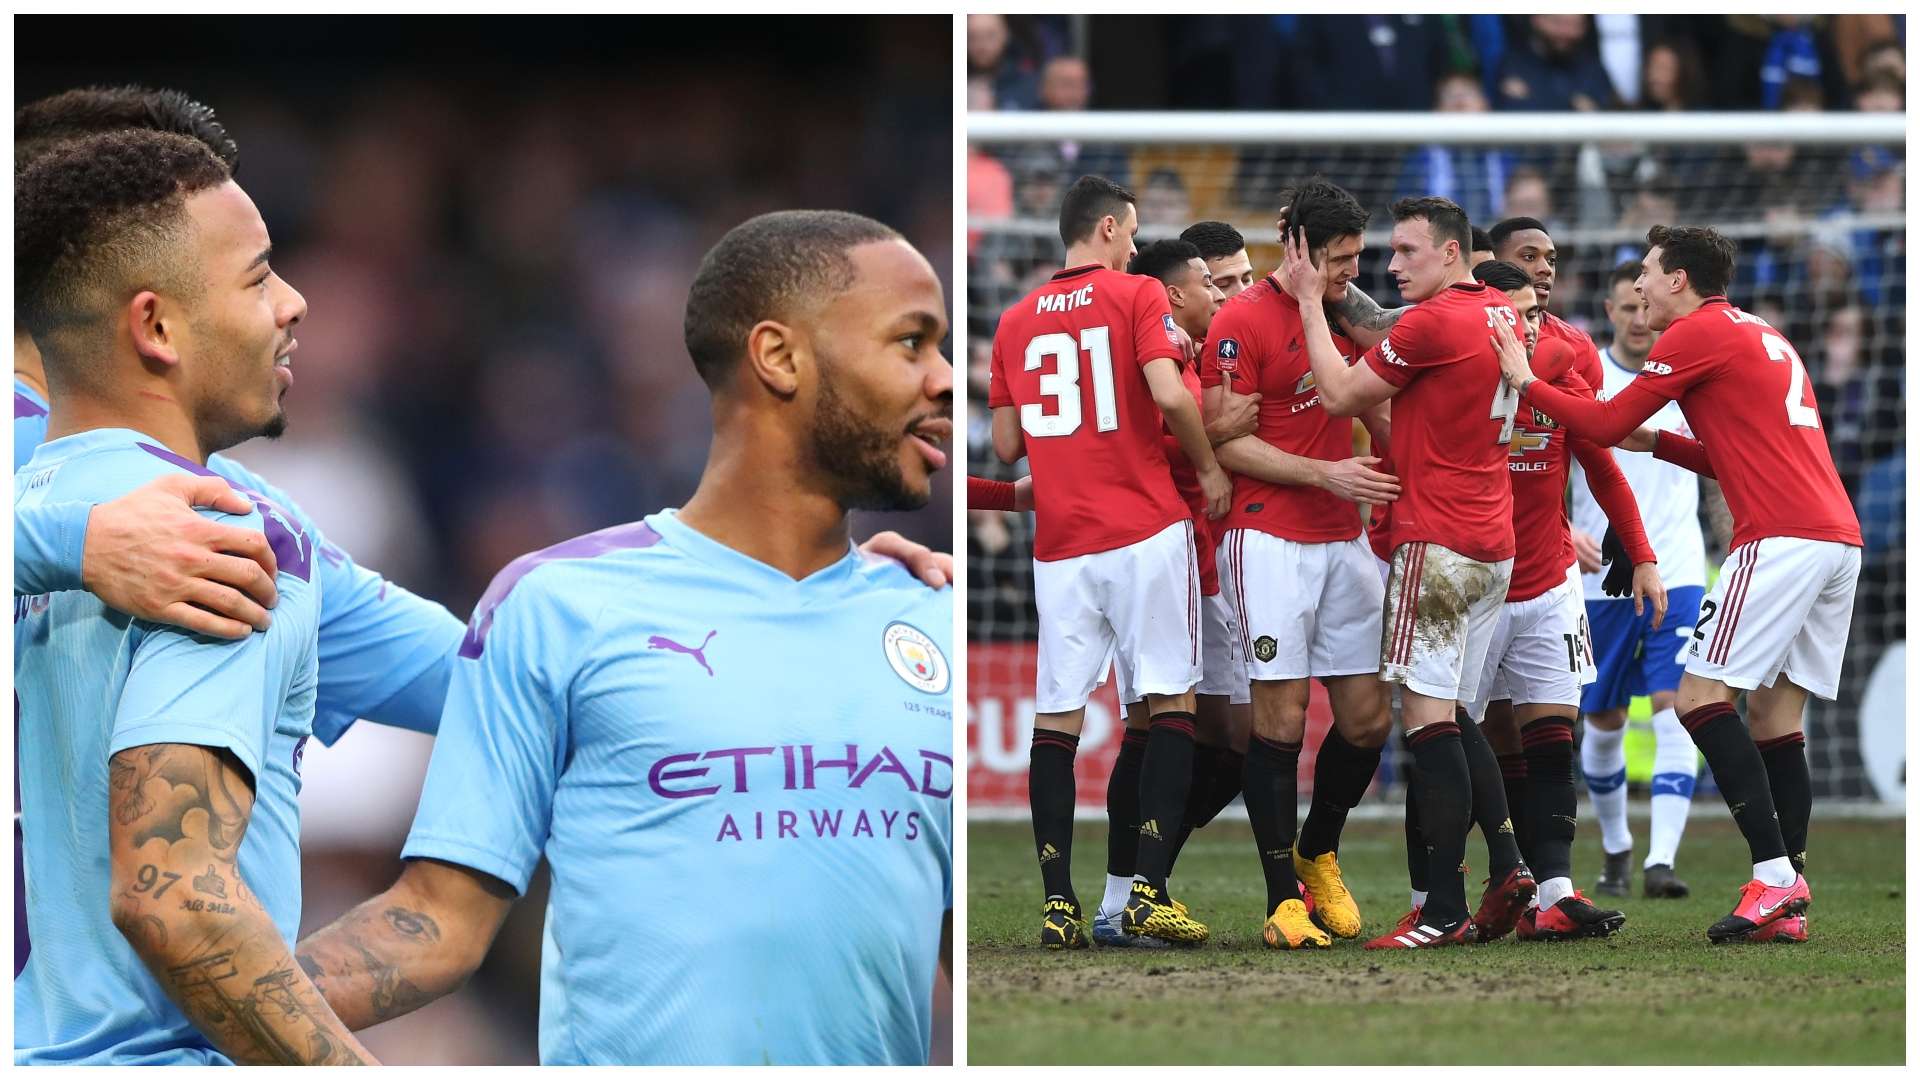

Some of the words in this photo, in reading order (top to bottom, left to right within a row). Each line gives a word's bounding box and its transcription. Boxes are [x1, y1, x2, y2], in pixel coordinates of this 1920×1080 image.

[1036, 283, 1094, 315] MATIĆ
[1021, 326, 1118, 437] 31
[1761, 332, 1820, 429] 2
[1489, 372, 1520, 444] 4
[1694, 600, 1717, 640] 2
[904, 701, 921, 712] 125
[923, 704, 952, 721] YEARS
[647, 744, 954, 800] ETIHAD
[715, 808, 920, 842] AIRWAYS
[132, 864, 182, 900] 97
